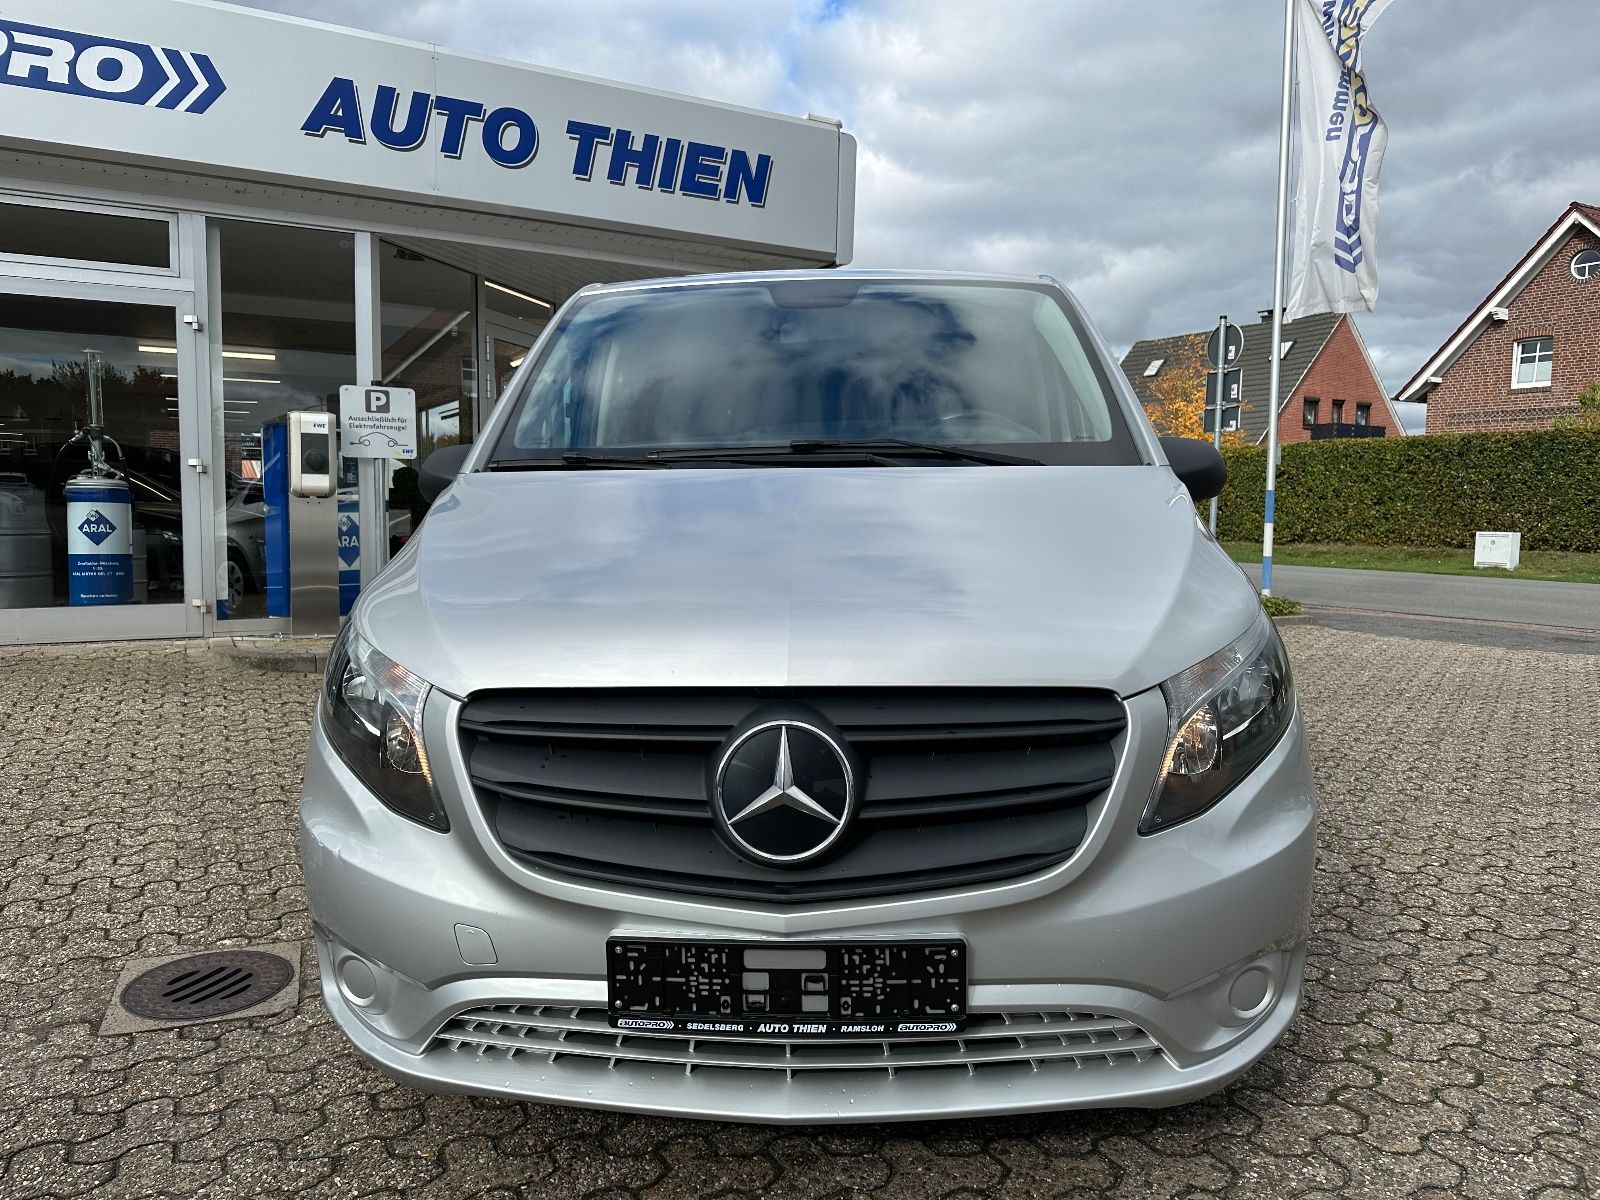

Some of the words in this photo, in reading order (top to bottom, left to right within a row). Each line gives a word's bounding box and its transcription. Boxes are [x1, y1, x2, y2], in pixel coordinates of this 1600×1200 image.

[0, 30, 144, 93] RO
[300, 76, 540, 170] AUTO
[565, 119, 774, 209] THIEN
[370, 391, 387, 412] P
[348, 415, 397, 423] Ausschließlich
[348, 423, 408, 431] Elektrofahrzeuge!
[82, 523, 113, 533] ARAL
[686, 1022, 744, 1031] SEDELSBERG
[757, 1023, 789, 1033] AUTO
[792, 1024, 827, 1033] THIEN
[840, 1024, 885, 1032] RAMSLOH
